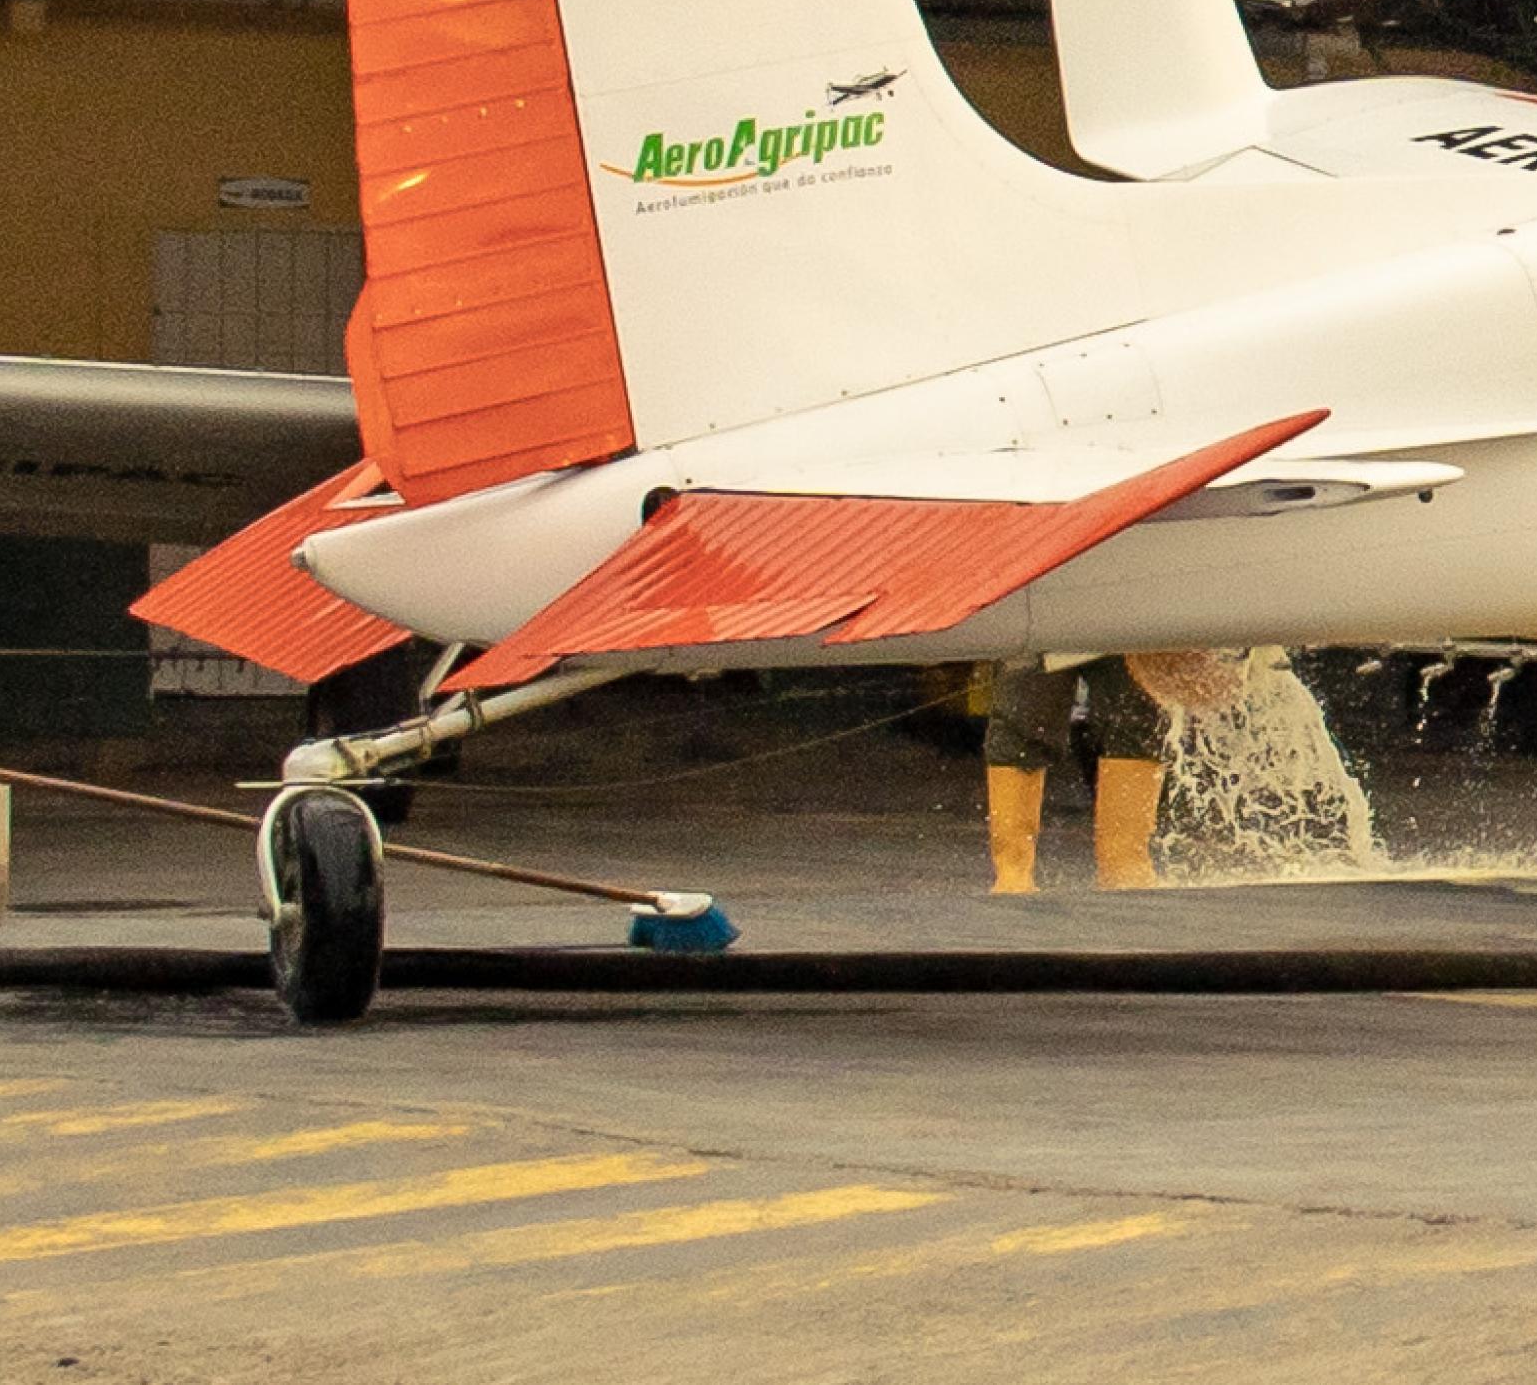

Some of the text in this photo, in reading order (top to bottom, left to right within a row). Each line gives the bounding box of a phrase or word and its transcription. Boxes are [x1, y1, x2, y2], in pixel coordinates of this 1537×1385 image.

[632, 109, 885, 184] AeroAgripac
[635, 184, 759, 215] Aerofumigación
[762, 175, 790, 194] que
[820, 163, 894, 185] confianza
